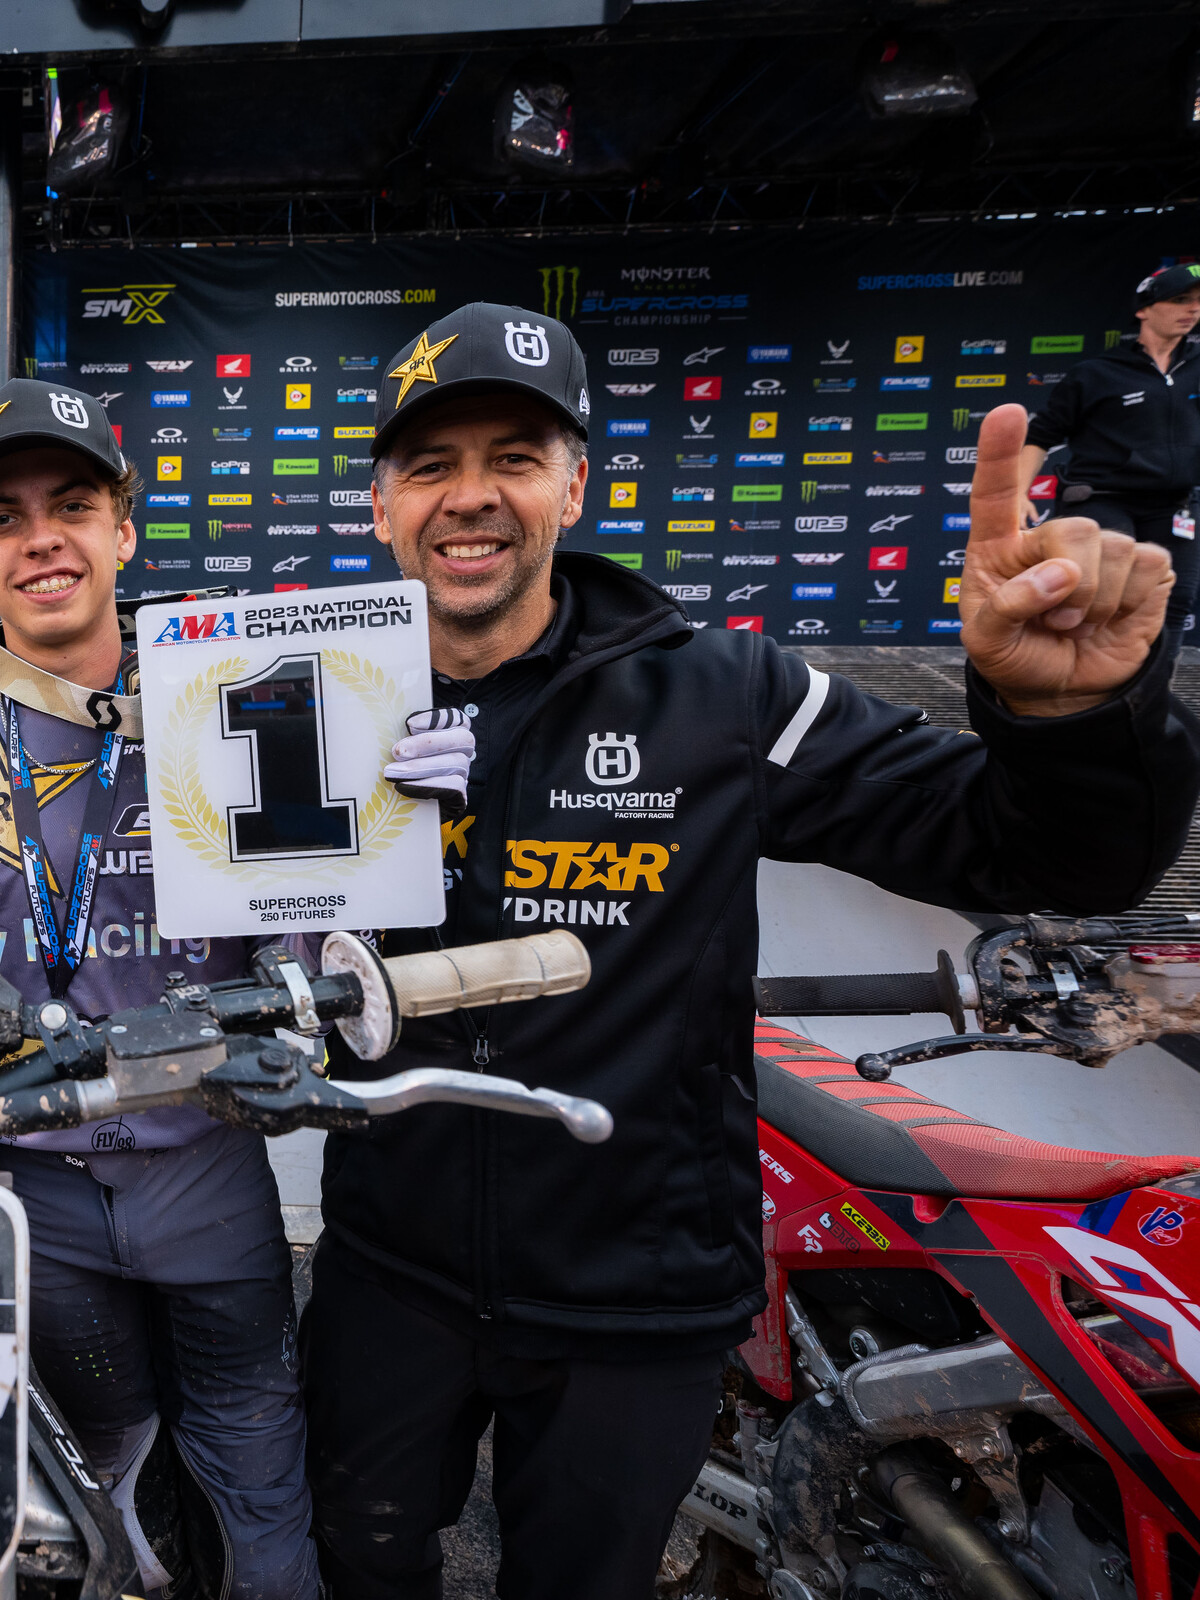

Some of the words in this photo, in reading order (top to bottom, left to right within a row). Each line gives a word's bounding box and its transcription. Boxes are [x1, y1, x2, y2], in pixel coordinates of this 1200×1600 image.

[621, 266, 711, 282] MONSTER
[857, 270, 1024, 290] SUPERCROSSLIVE.COM
[275, 289, 436, 307] SUPERMOTOCROSS.COM
[81, 292, 170, 324] SMX
[614, 314, 712, 327] CHAMPIONSHIP
[961, 340, 1007, 349] GoPro
[608, 349, 659, 365] WPS
[146, 360, 193, 371] FLY
[605, 383, 657, 394] FLY
[883, 376, 931, 387] FALKEN
[960, 377, 1002, 385] SUZUKI
[337, 388, 378, 396] GoPro
[809, 416, 853, 424] GoPro
[739, 454, 785, 462] FALKEN
[672, 487, 715, 495] GoPro
[329, 523, 375, 533] FLY
[795, 516, 848, 533] WPS
[205, 556, 251, 572] WPS
[340, 559, 368, 567] YAMAHA
[792, 553, 845, 564] FLY
[245, 606, 300, 622] 2023
[303, 596, 412, 616] NATIONAL
[152, 612, 240, 643] AMA
[245, 610, 413, 639] CHAMPION
[219, 652, 360, 863] 1
[550, 789, 677, 811] Husqvarna
[505, 840, 670, 893] STAR
[66, 832, 93, 940] SUPERCROSS
[80, 867, 95, 920] FUTURES
[29, 884, 47, 937] FUTURES
[249, 895, 347, 911] SUPERCROSS
[33, 861, 59, 966] SUPERCROSS
[260, 912, 280, 922] 250
[282, 909, 336, 921] FUTURES
[841, 1206, 890, 1250] ACERBIS
[1139, 1206, 1185, 1237] VP
[694, 1483, 748, 1520] LOP
